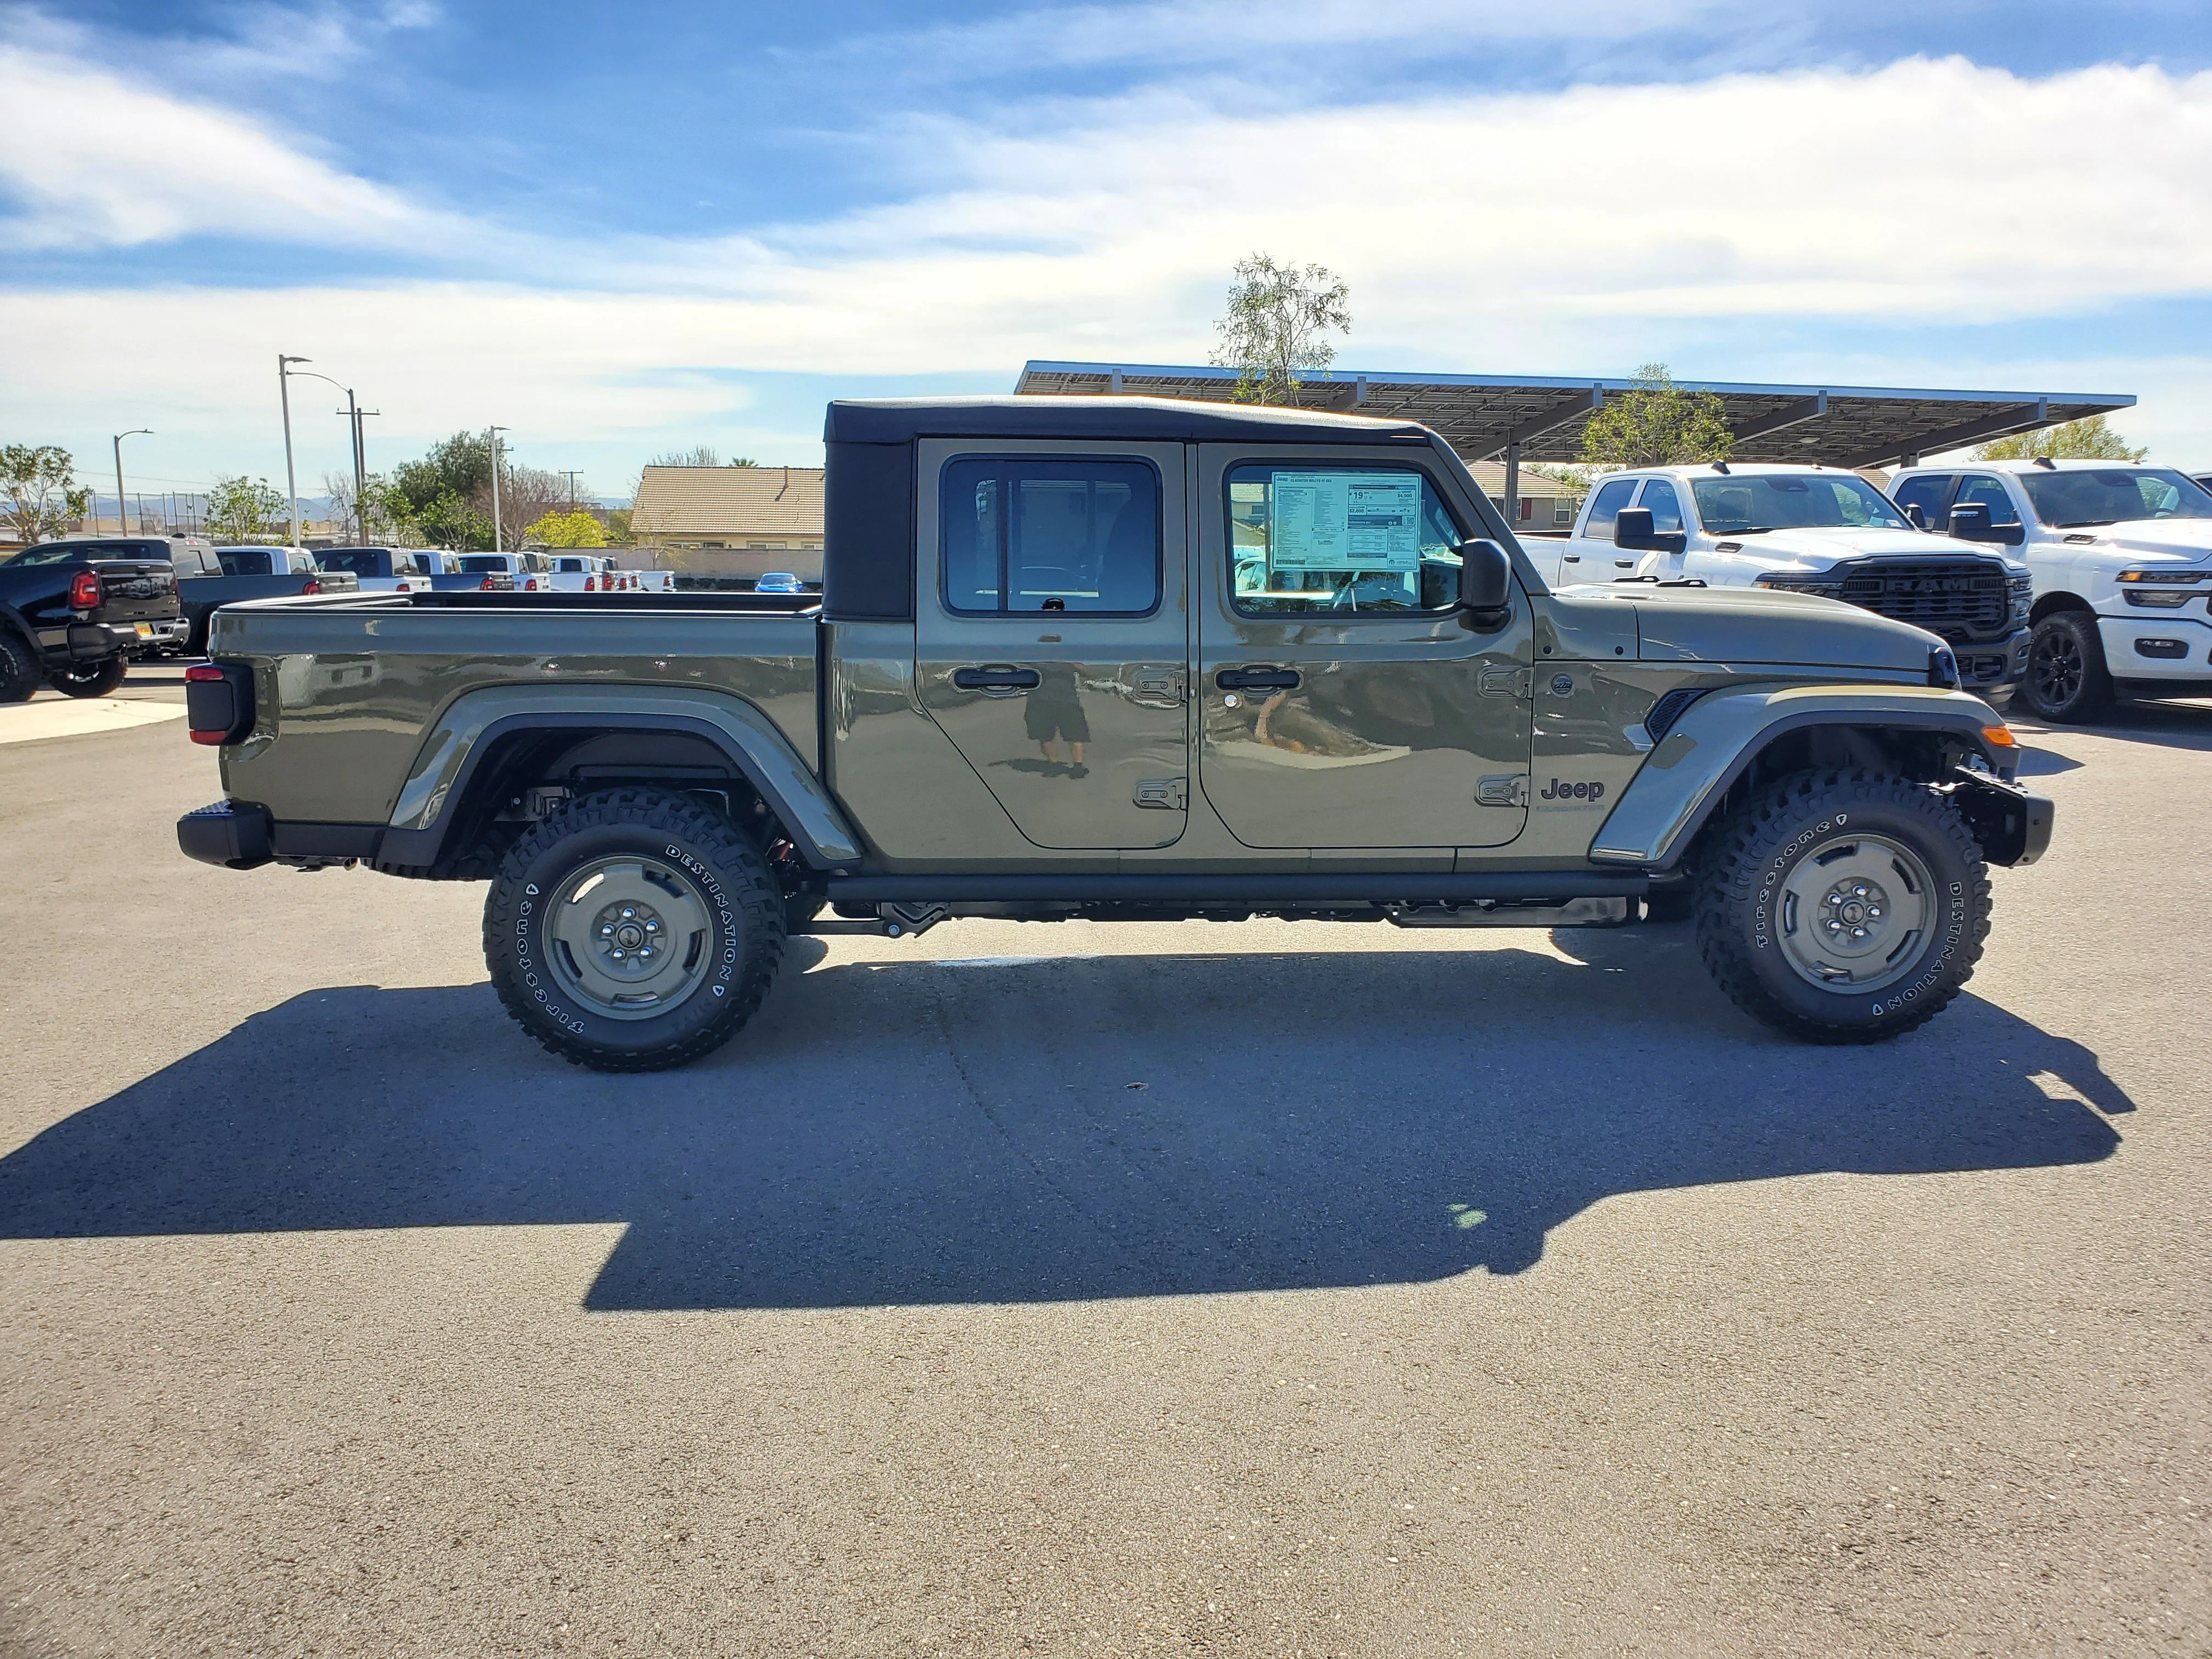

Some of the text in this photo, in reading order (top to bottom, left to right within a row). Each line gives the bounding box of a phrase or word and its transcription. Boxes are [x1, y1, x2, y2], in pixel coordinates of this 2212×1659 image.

[1886, 578, 1969, 592] RAM
[1541, 778, 1605, 803] Jeep
[664, 844, 737, 981] DESTINATION
[1755, 821, 1831, 949] Firestone
[1887, 881, 1965, 1011] DESTINATION
[516, 900, 586, 1034] Firestone
